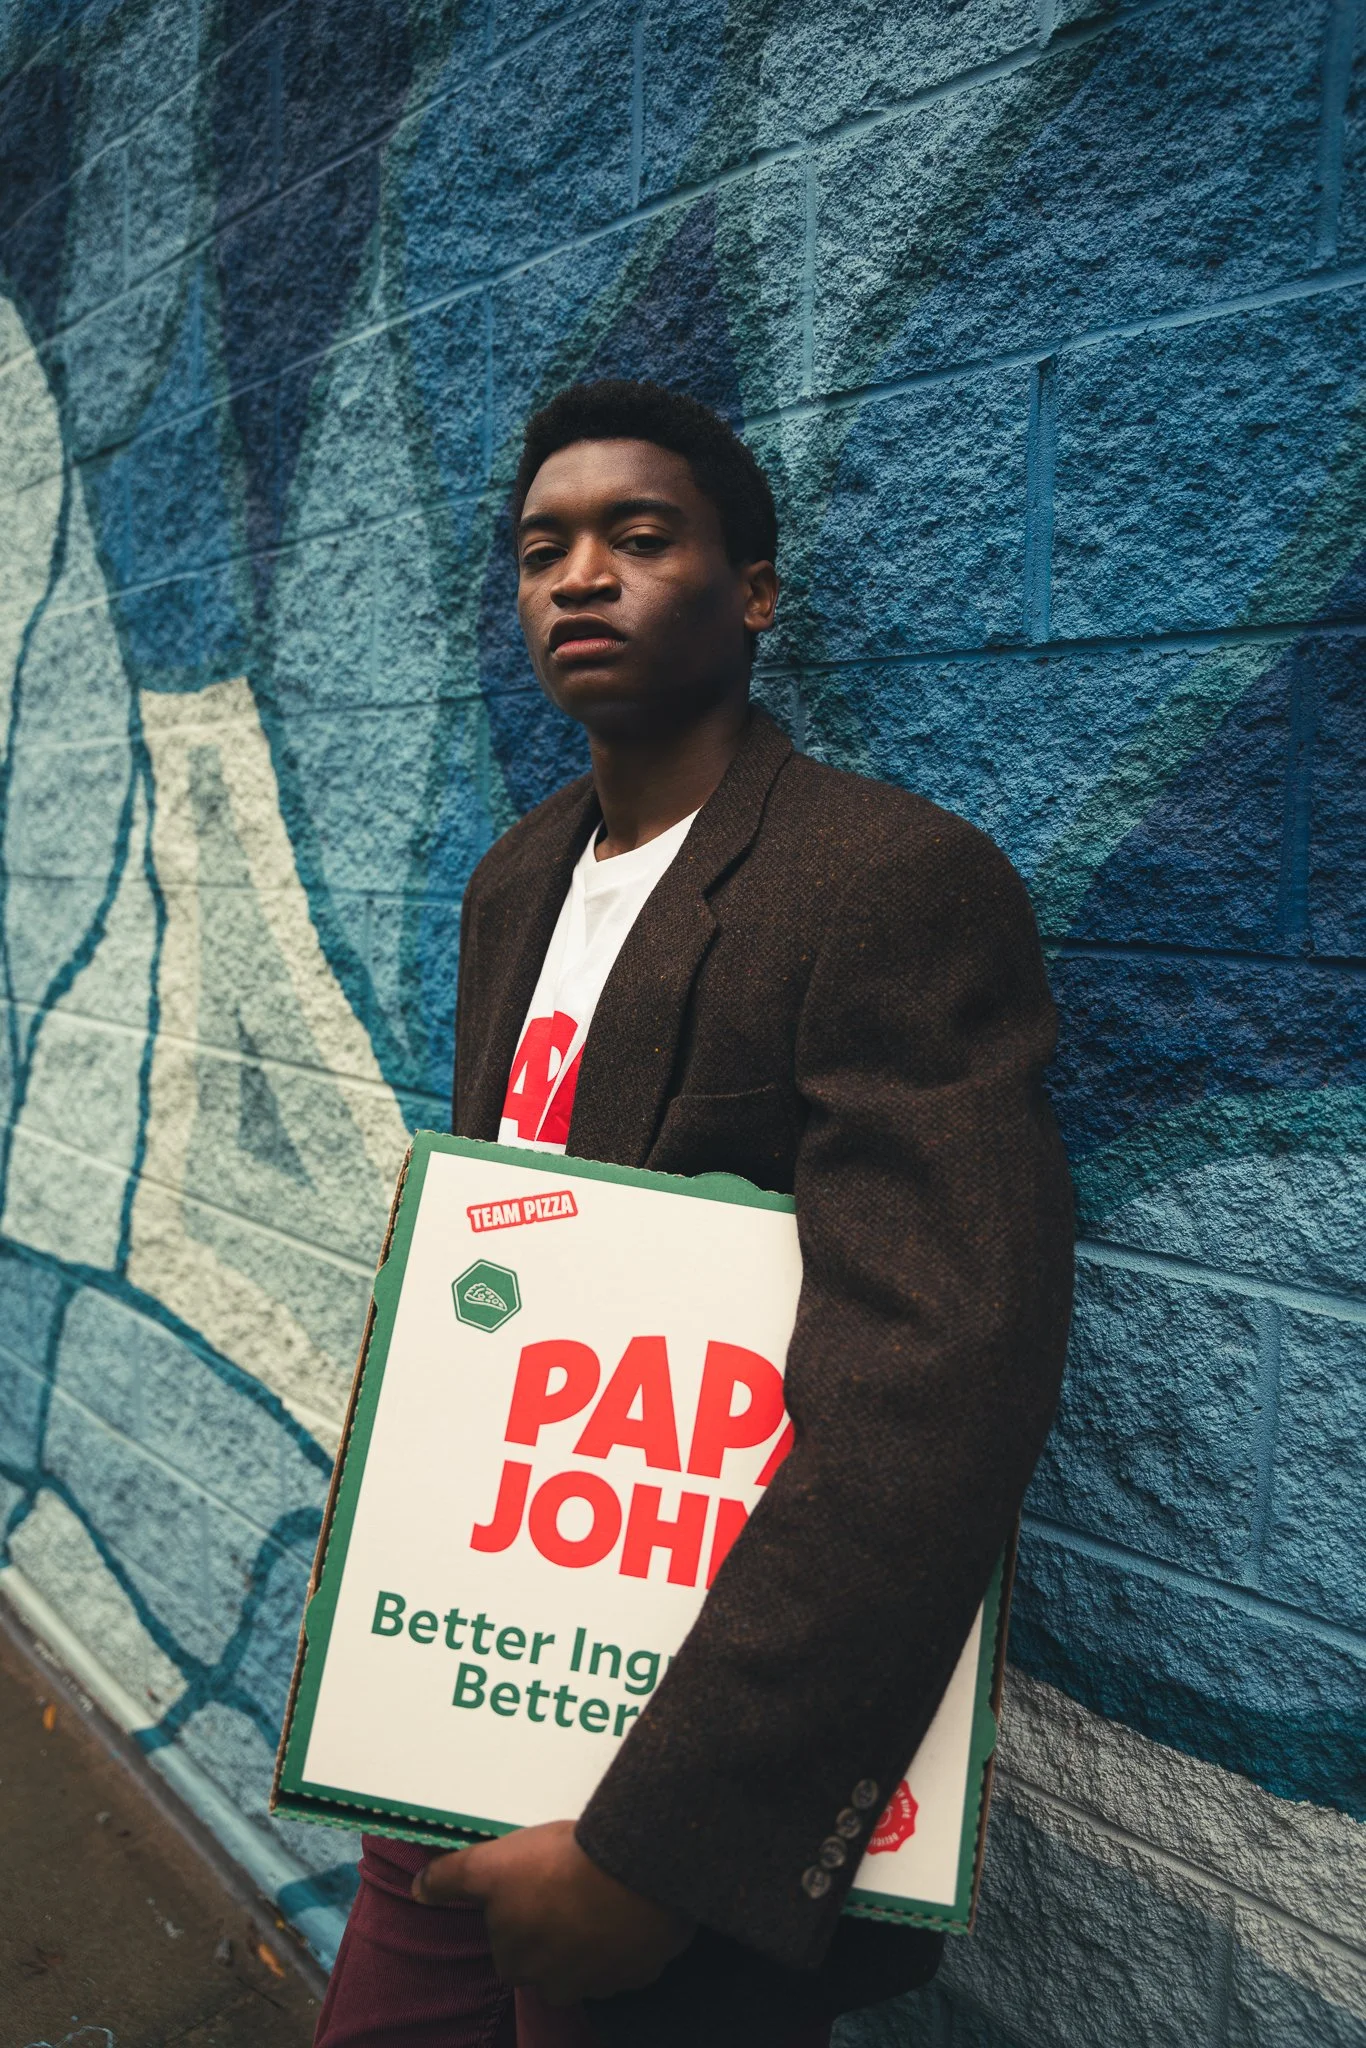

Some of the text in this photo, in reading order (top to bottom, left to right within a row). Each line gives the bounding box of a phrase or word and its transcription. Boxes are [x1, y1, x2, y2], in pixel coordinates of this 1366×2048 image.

[470, 1194, 574, 1230] TEAM PIZZA
[370, 1590, 677, 1696] Better Ing
[452, 1662, 640, 1738] Better
